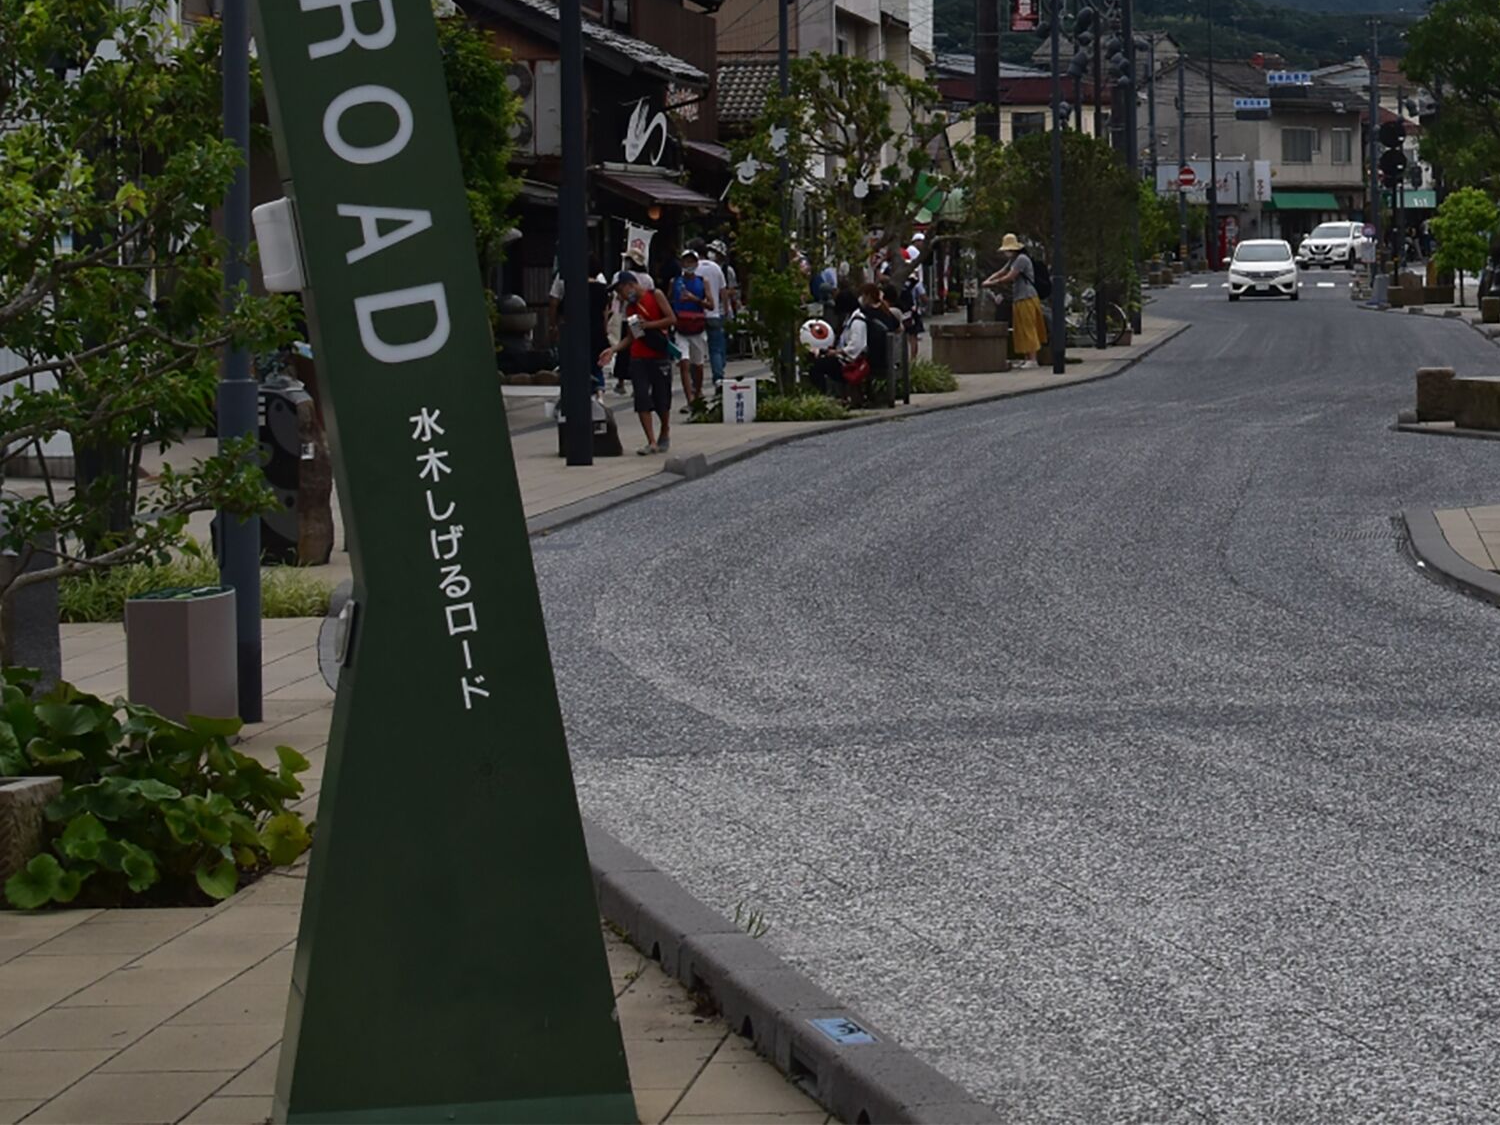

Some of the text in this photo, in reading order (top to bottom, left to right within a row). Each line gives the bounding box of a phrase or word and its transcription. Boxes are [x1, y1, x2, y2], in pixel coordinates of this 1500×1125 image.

[409, 406, 490, 710] 水木しげるロード
